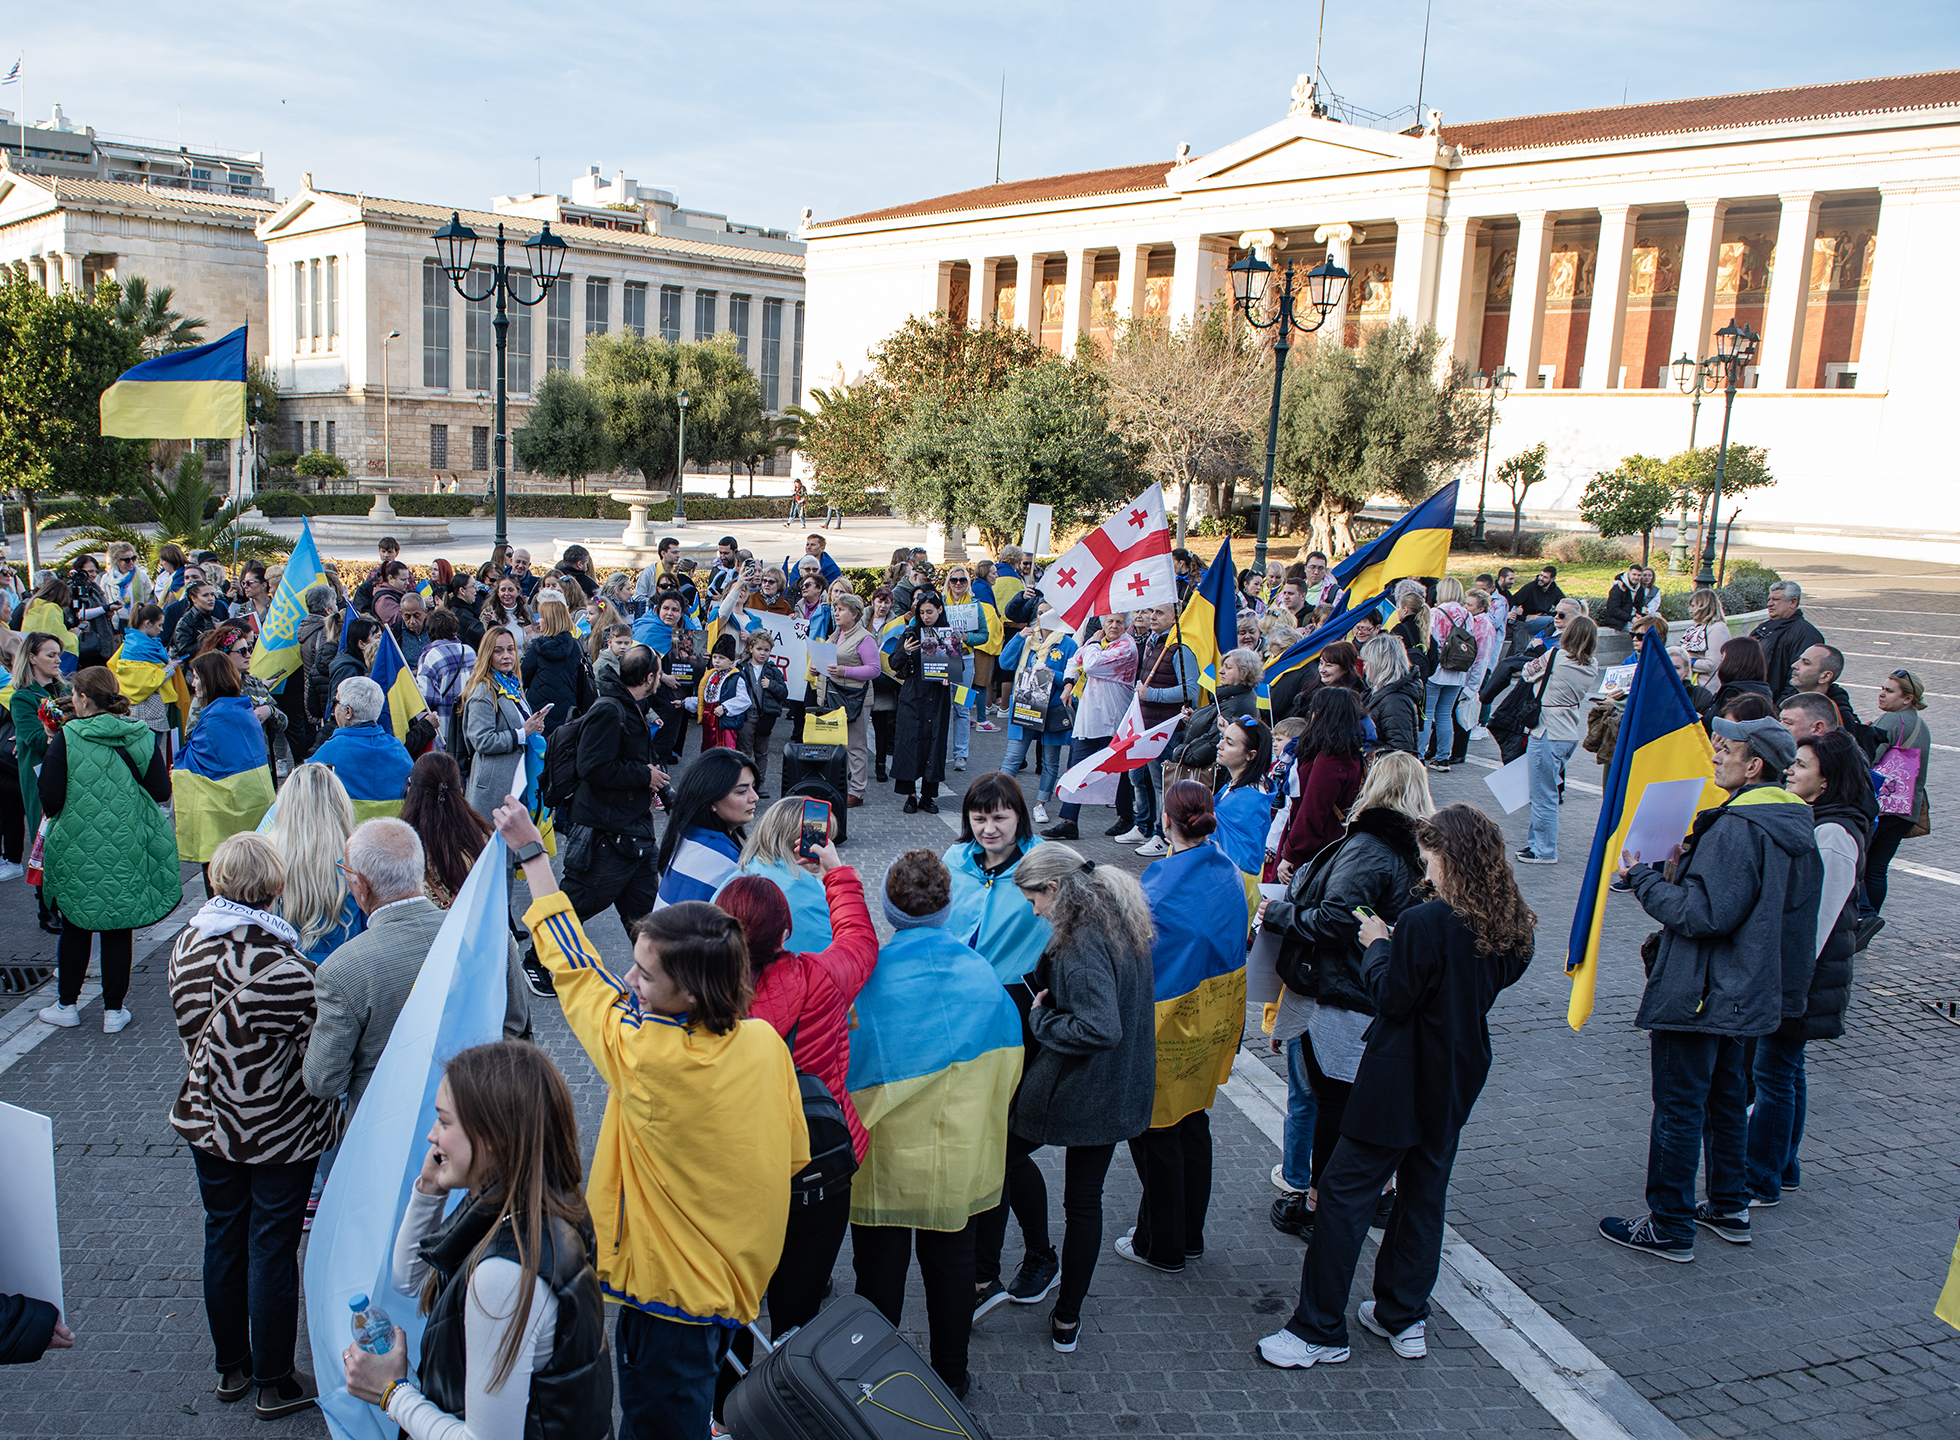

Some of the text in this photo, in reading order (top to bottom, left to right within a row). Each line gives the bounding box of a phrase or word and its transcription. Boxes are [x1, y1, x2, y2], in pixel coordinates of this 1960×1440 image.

[946, 610, 973, 621] KRAINE
[794, 622, 809, 633] STO
[214, 897, 254, 916] POLO
